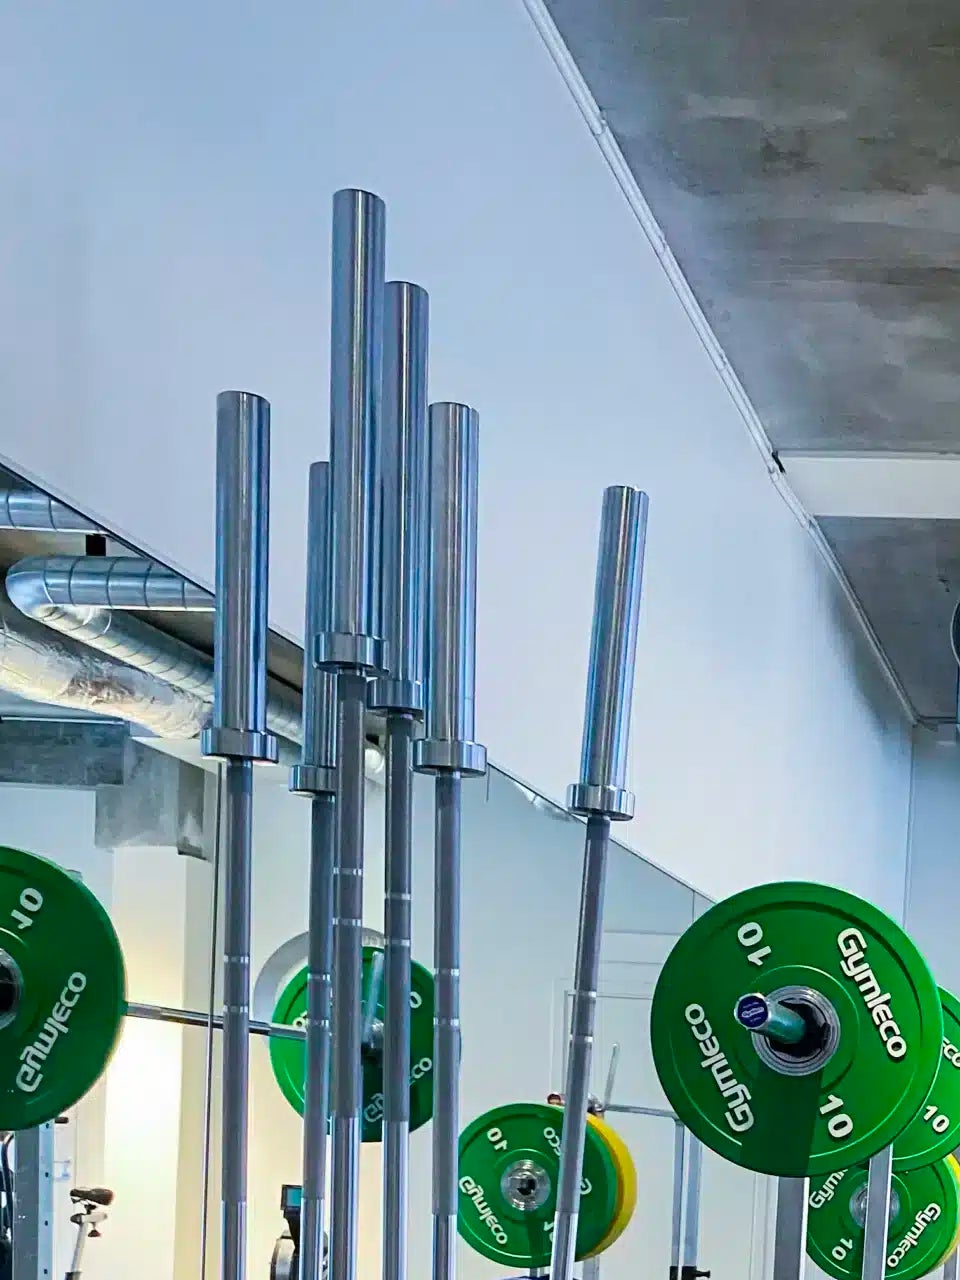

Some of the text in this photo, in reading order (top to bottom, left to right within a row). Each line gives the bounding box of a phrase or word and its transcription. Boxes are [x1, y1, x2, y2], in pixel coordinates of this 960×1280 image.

[737, 921, 772, 966] 10
[837, 927, 908, 1059] Gymleco
[684, 1003, 755, 1133] Gymleco
[819, 1094, 853, 1138] 10
[923, 1105, 949, 1133] 10
[832, 1238, 853, 1261] 10
[887, 1203, 941, 1268] Gymleco
